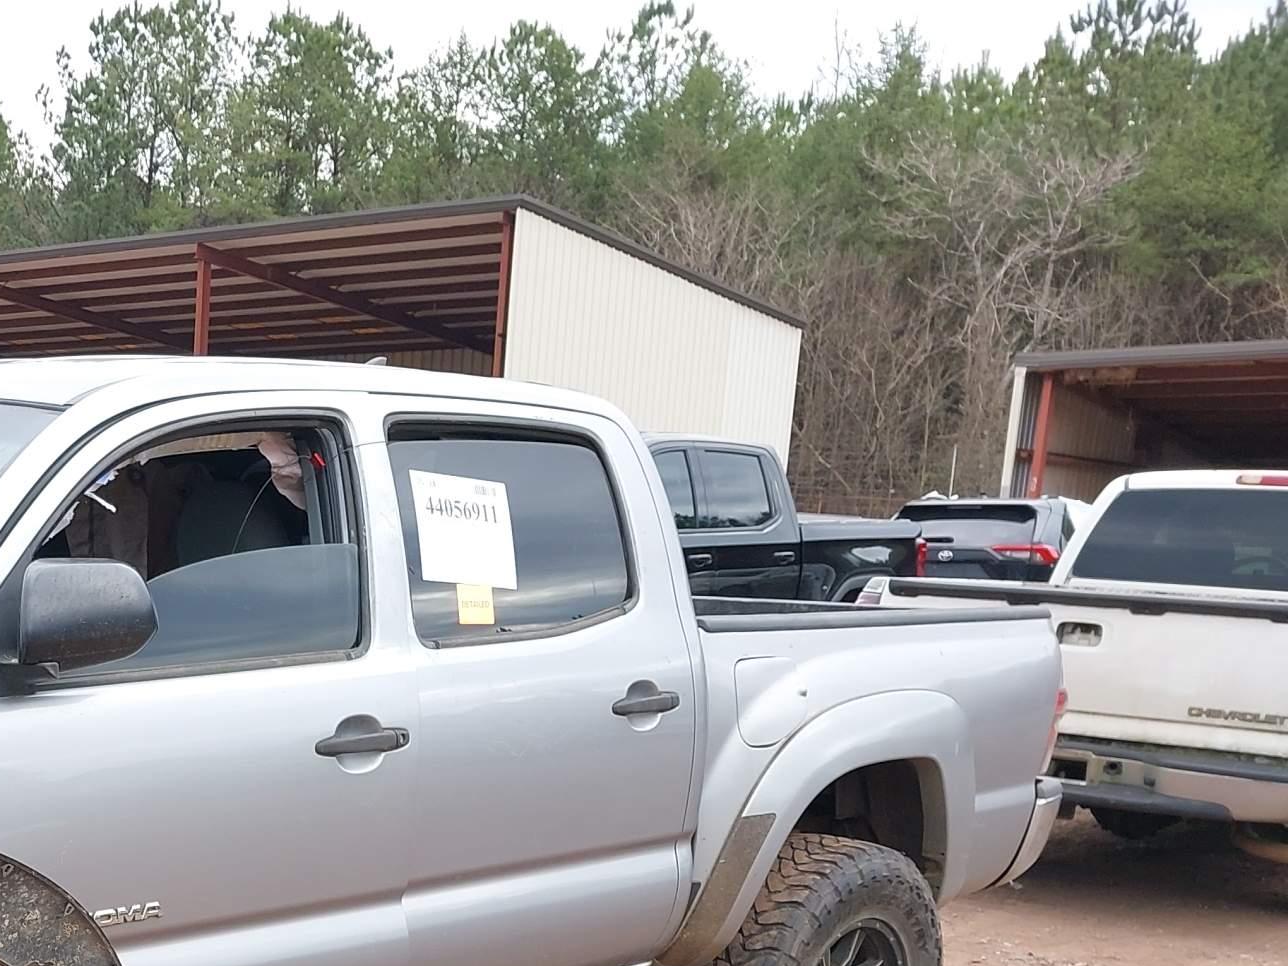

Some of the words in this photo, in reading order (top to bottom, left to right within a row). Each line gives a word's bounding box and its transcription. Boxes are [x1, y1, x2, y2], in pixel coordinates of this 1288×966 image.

[425, 495, 498, 524] 44056911
[1187, 706, 1288, 725] CHEVROLET
[90, 900, 162, 927] OMA
